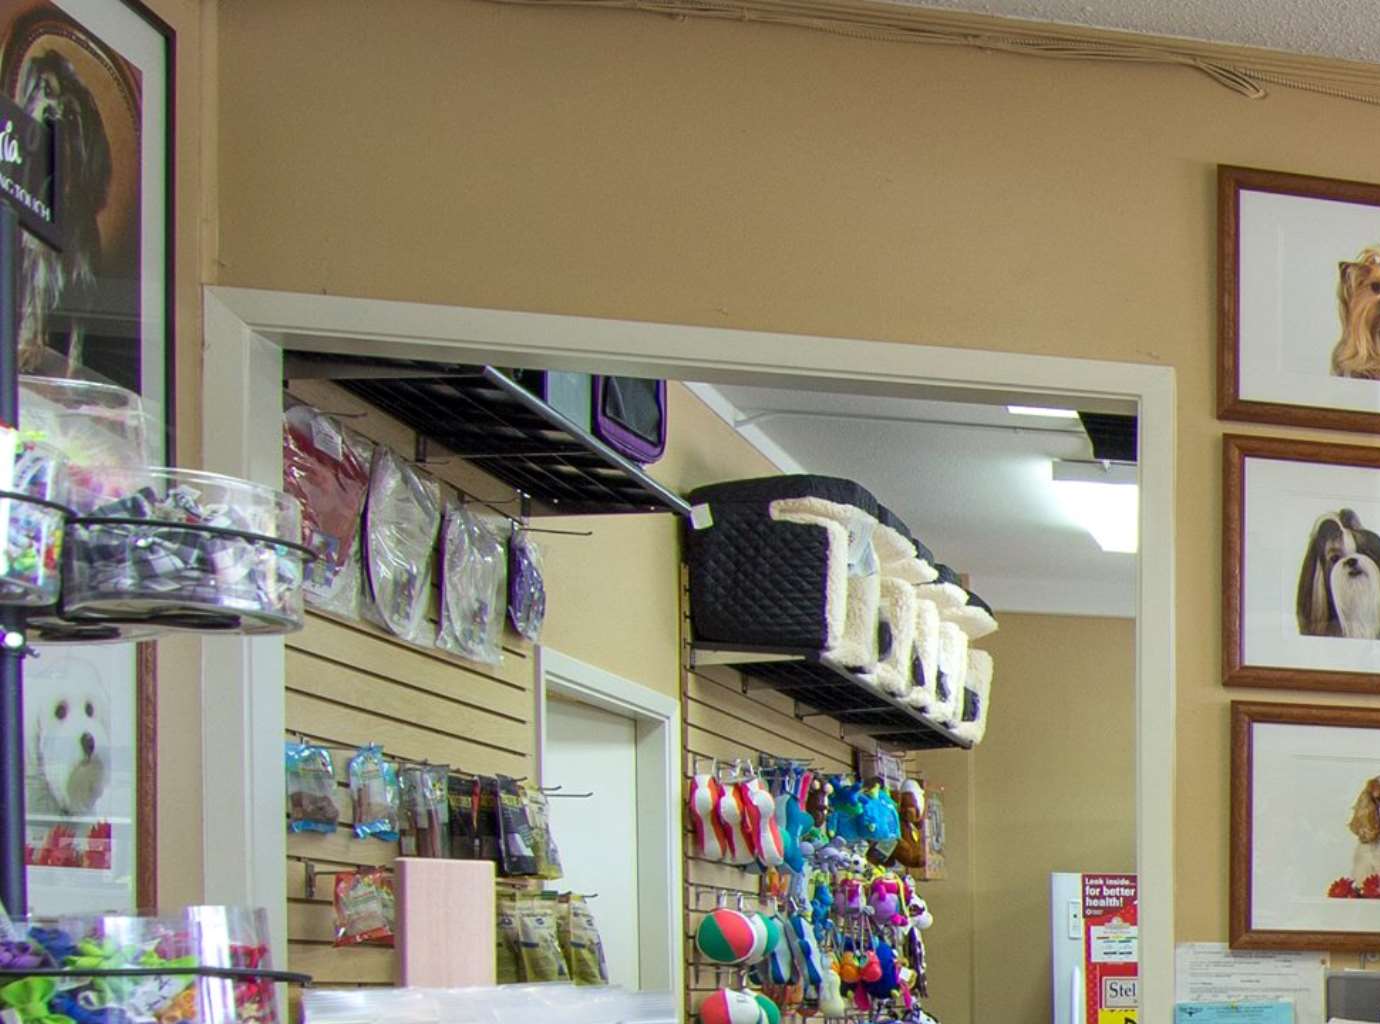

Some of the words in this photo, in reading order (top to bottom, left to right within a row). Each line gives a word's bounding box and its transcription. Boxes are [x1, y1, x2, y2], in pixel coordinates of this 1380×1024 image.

[1085, 886, 1101, 897] for
[1102, 885, 1136, 898] better
[1085, 896, 1125, 908] health!
